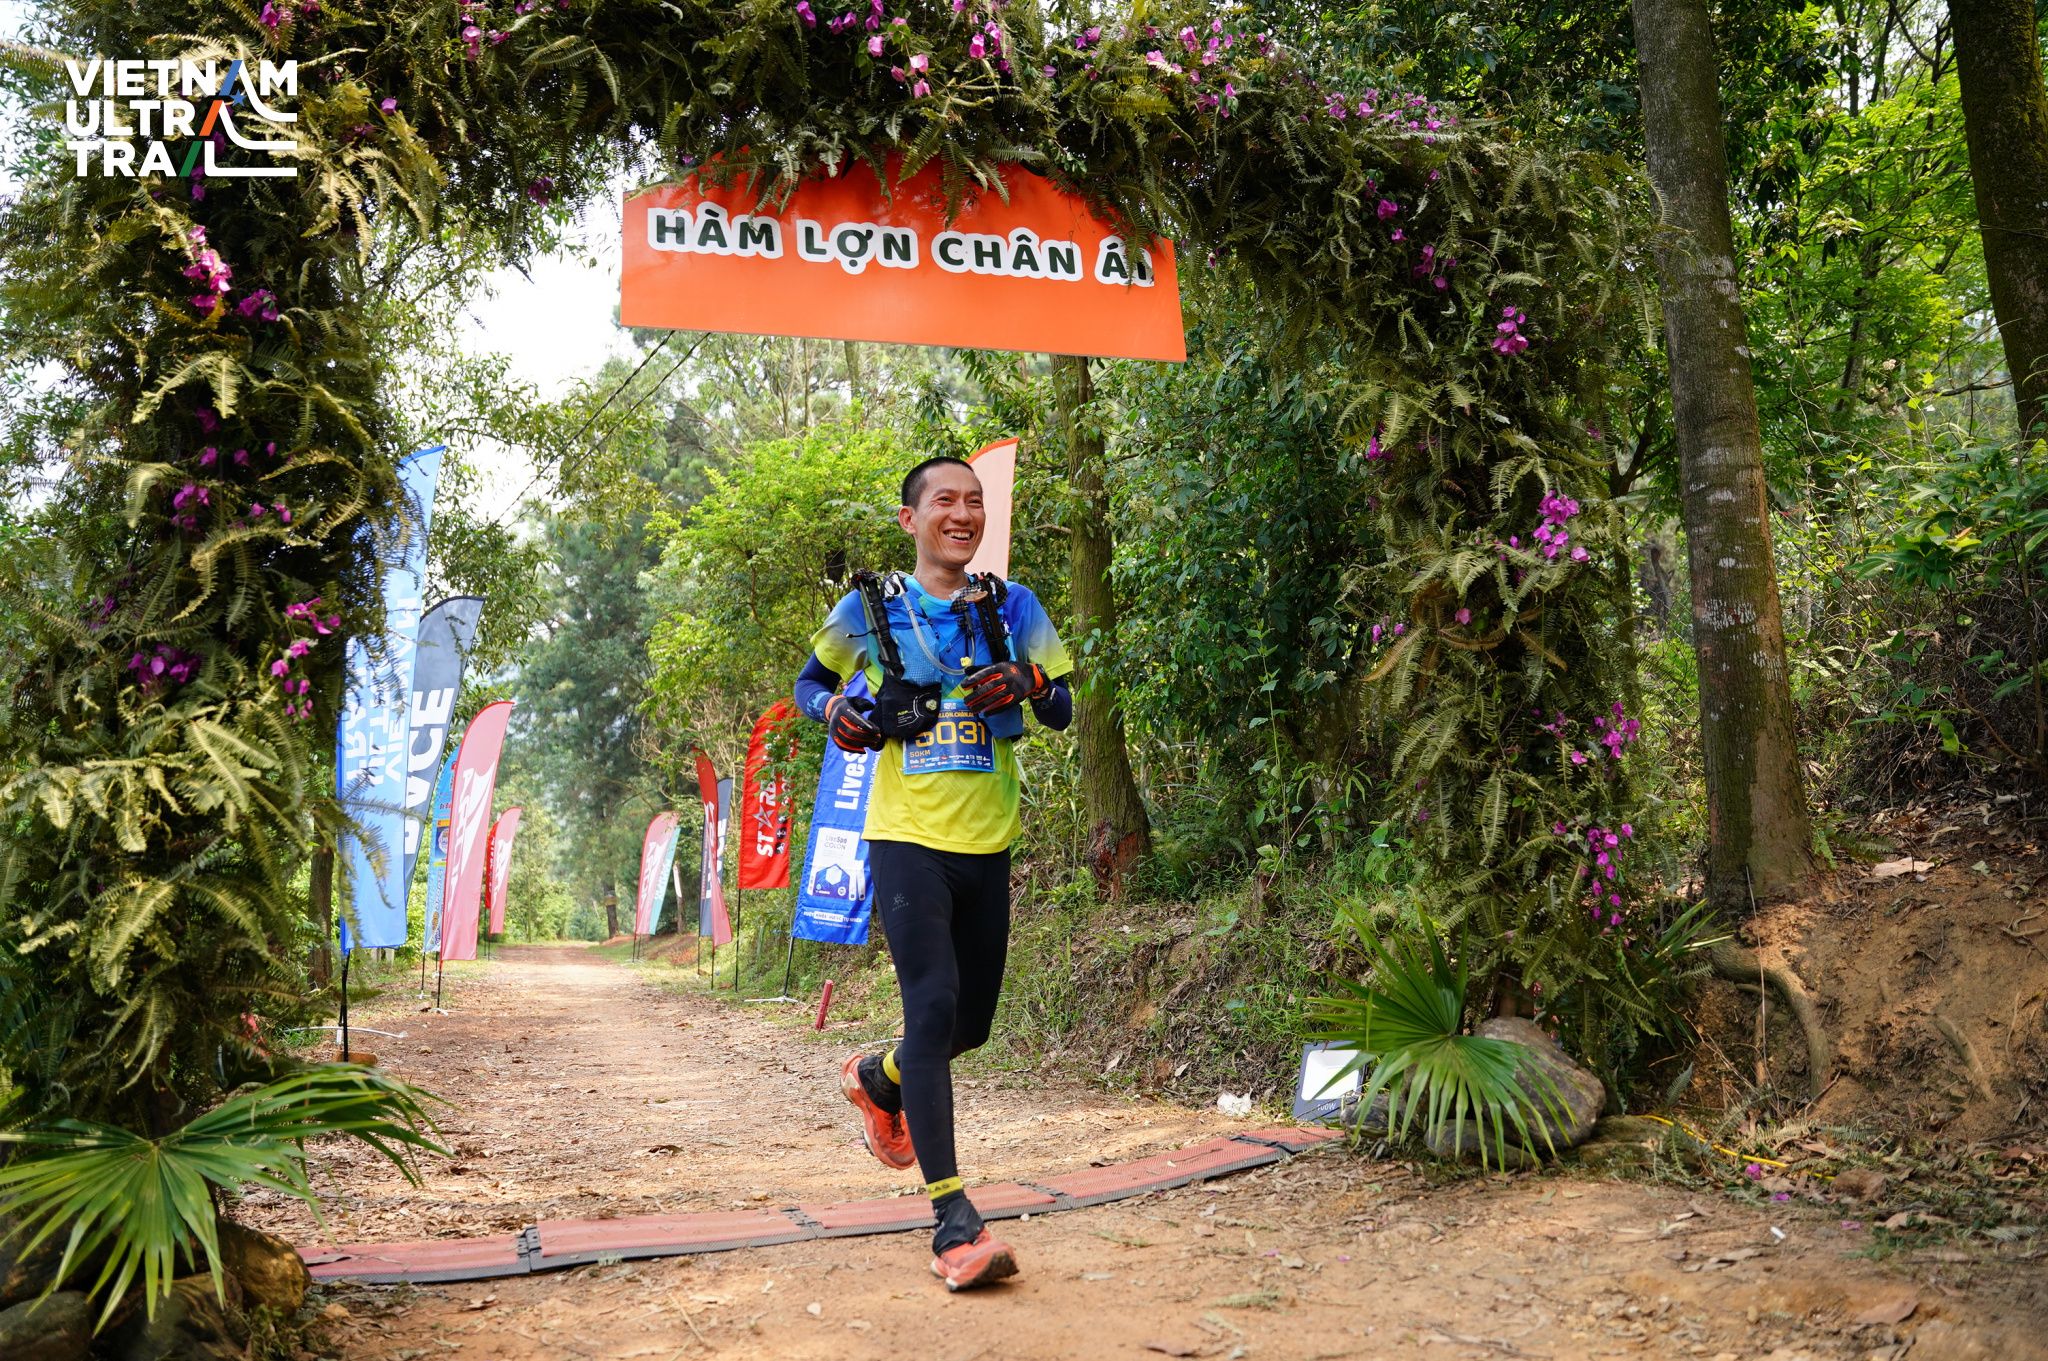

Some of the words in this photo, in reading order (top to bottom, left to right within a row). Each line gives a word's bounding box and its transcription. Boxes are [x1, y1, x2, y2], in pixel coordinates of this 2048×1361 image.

[654, 207, 775, 252] HÀM
[803, 224, 912, 268] LỢN
[938, 234, 1077, 275] CHÂN
